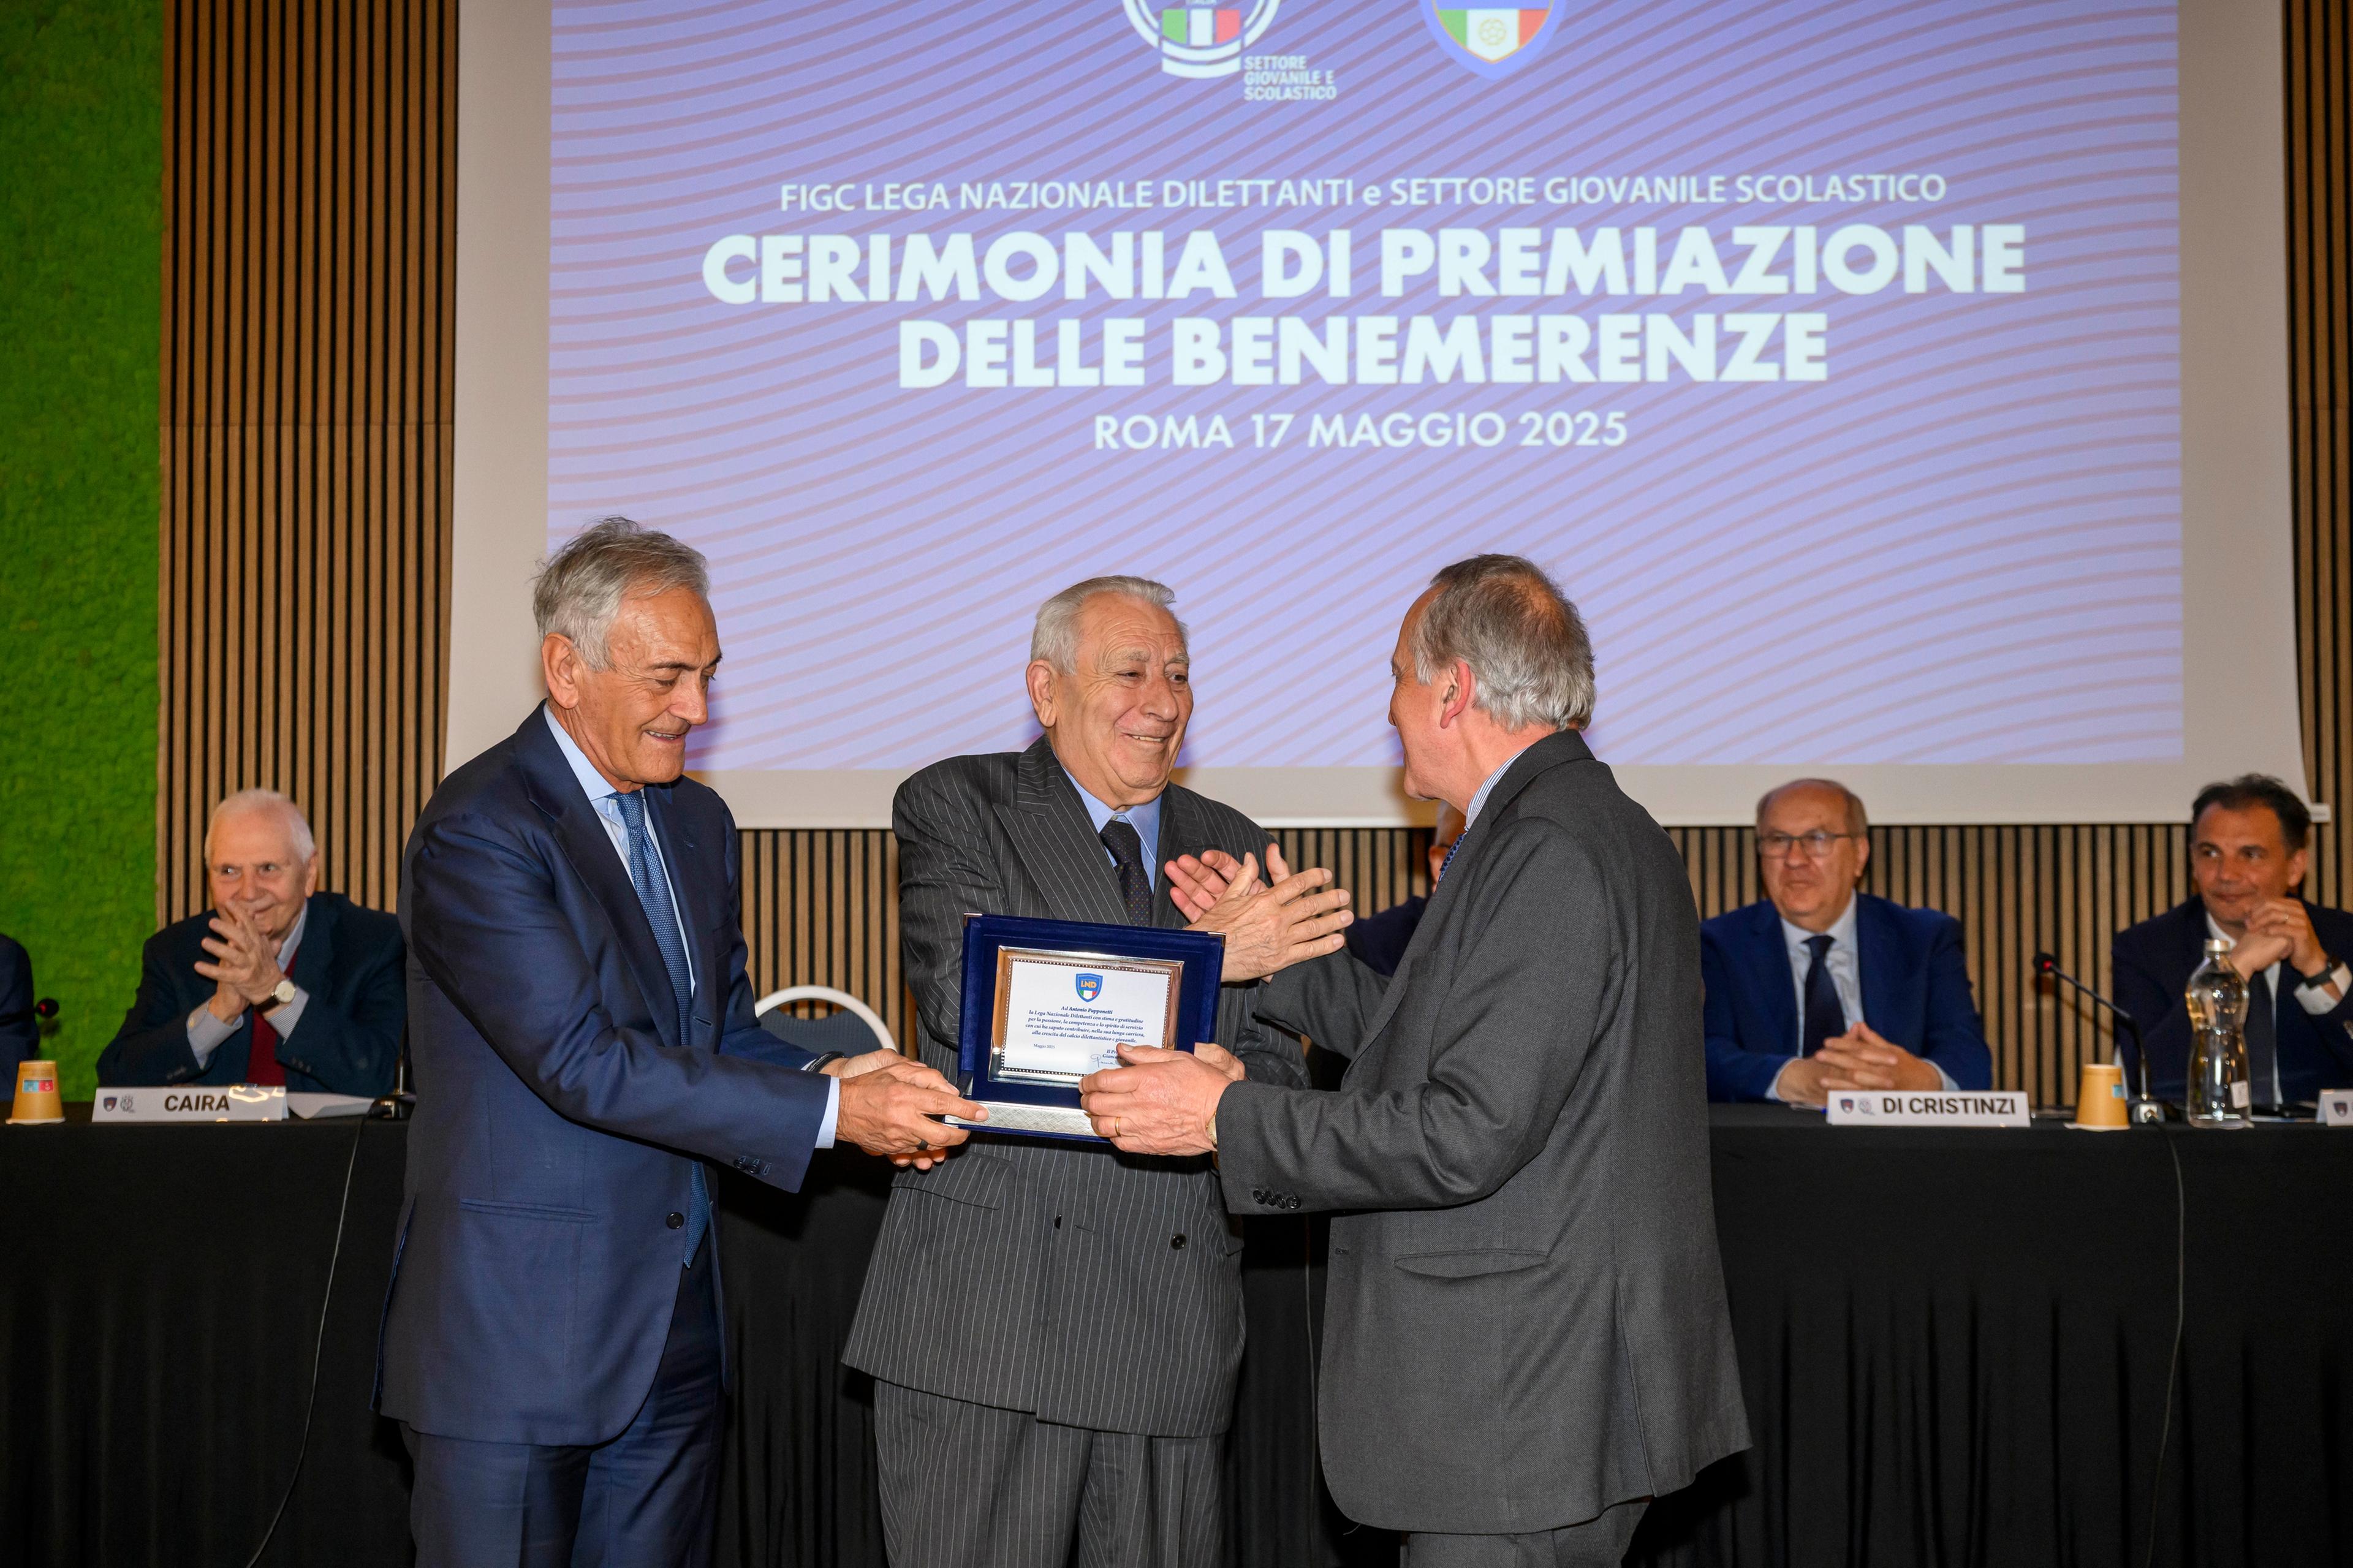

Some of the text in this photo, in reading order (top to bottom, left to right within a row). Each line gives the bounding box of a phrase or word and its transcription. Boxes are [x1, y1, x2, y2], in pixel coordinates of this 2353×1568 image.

[1245, 56, 1306, 70] SETTORE
[1245, 70, 1334, 85] GIOVANILE E
[1245, 86, 1337, 100] SCOLASTICO
[781, 174, 1946, 211] FIGC LEGA NAZIONALE DILETTANTI e SETTORE GIOVANILE SCOLASTICO
[702, 224, 2025, 305] CERIMONIA DI PREMIAZIONE
[899, 312, 1827, 388] DELLE BENEMERENZE
[1094, 411, 1627, 450] ROMA 17 MAGGIO 2025
[1080, 980, 1097, 988] LND
[164, 1094, 230, 1112] CAIRA
[1883, 1098, 1902, 1114] DI
[1909, 1097, 2015, 1114] CRISTINZI
